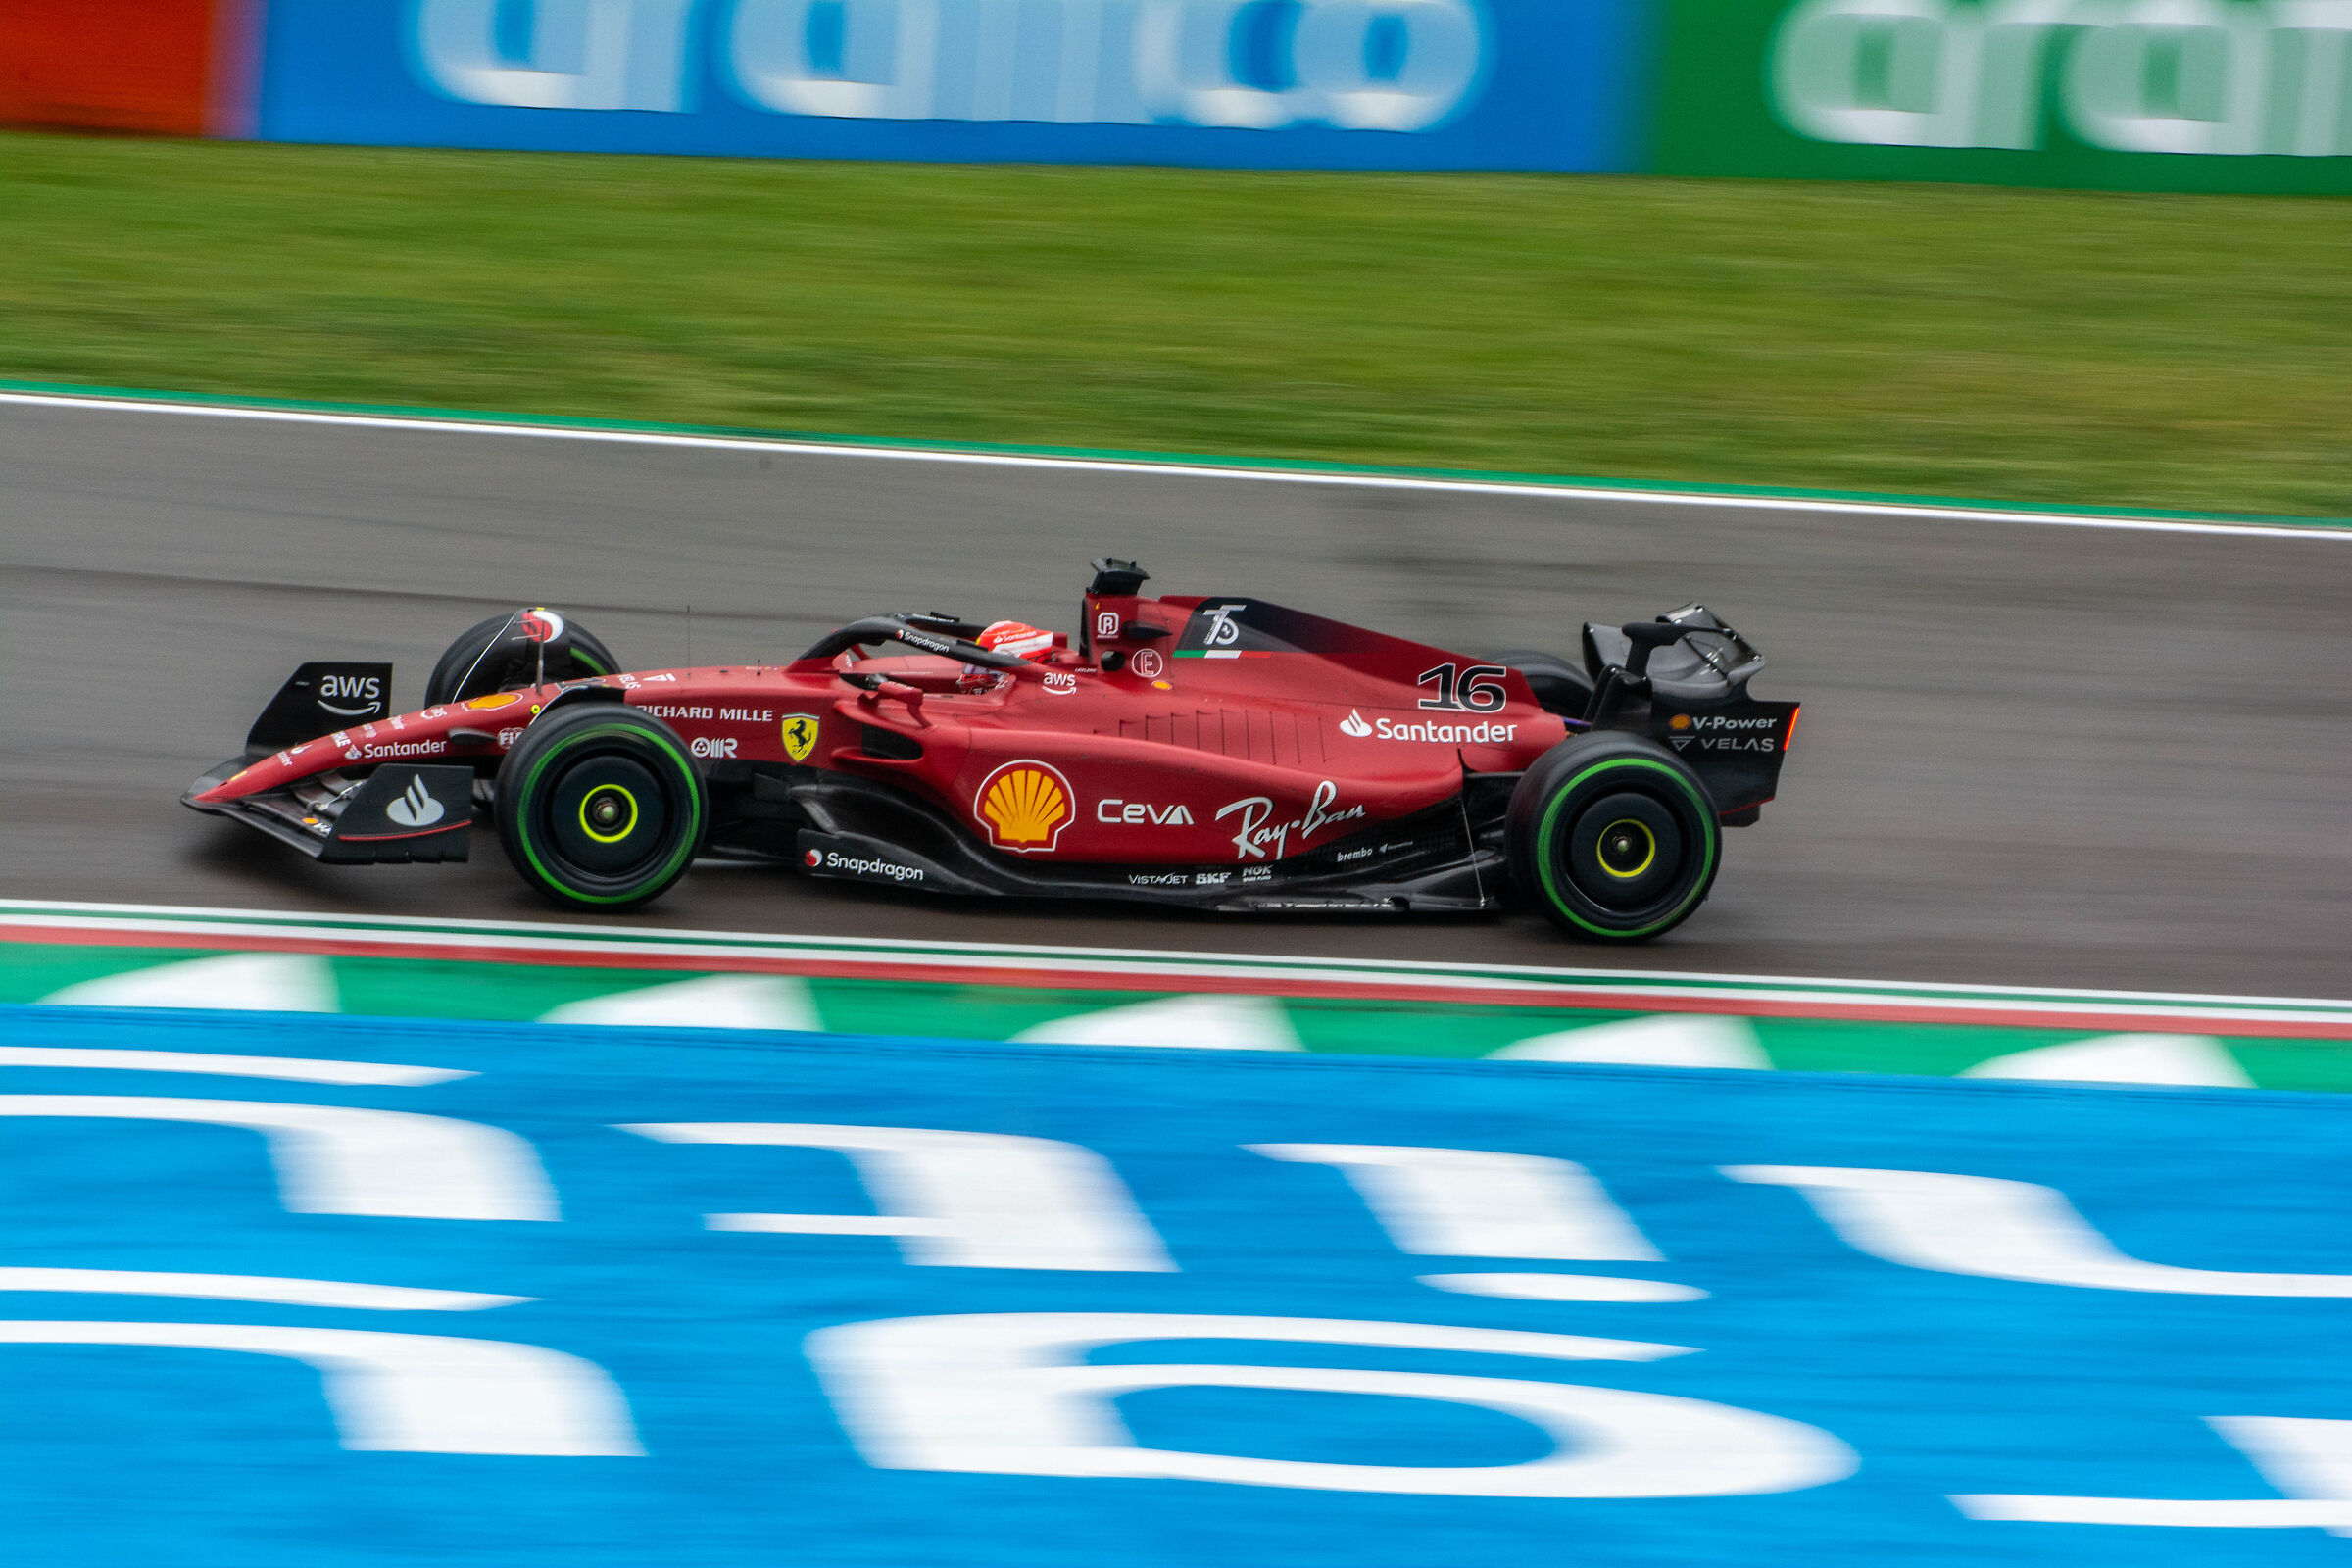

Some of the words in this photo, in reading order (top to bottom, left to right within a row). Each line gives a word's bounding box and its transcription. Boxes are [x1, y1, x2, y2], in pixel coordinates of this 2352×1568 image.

[904, 631, 950, 653] Snapdragon
[320, 674, 380, 699] aws
[1043, 672, 1076, 687] aws
[1417, 662, 1507, 713] 16
[719, 708, 773, 722] MILLE
[1691, 716, 1778, 730] V-Power
[1375, 718, 1518, 744] Santander
[363, 739, 447, 759] Santander
[1700, 737, 1775, 752] VELAS
[1337, 847, 1373, 862] brembo
[826, 852, 924, 881] Snapdragon
[1242, 864, 1273, 878] NGK
[1195, 872, 1232, 885] SKF
